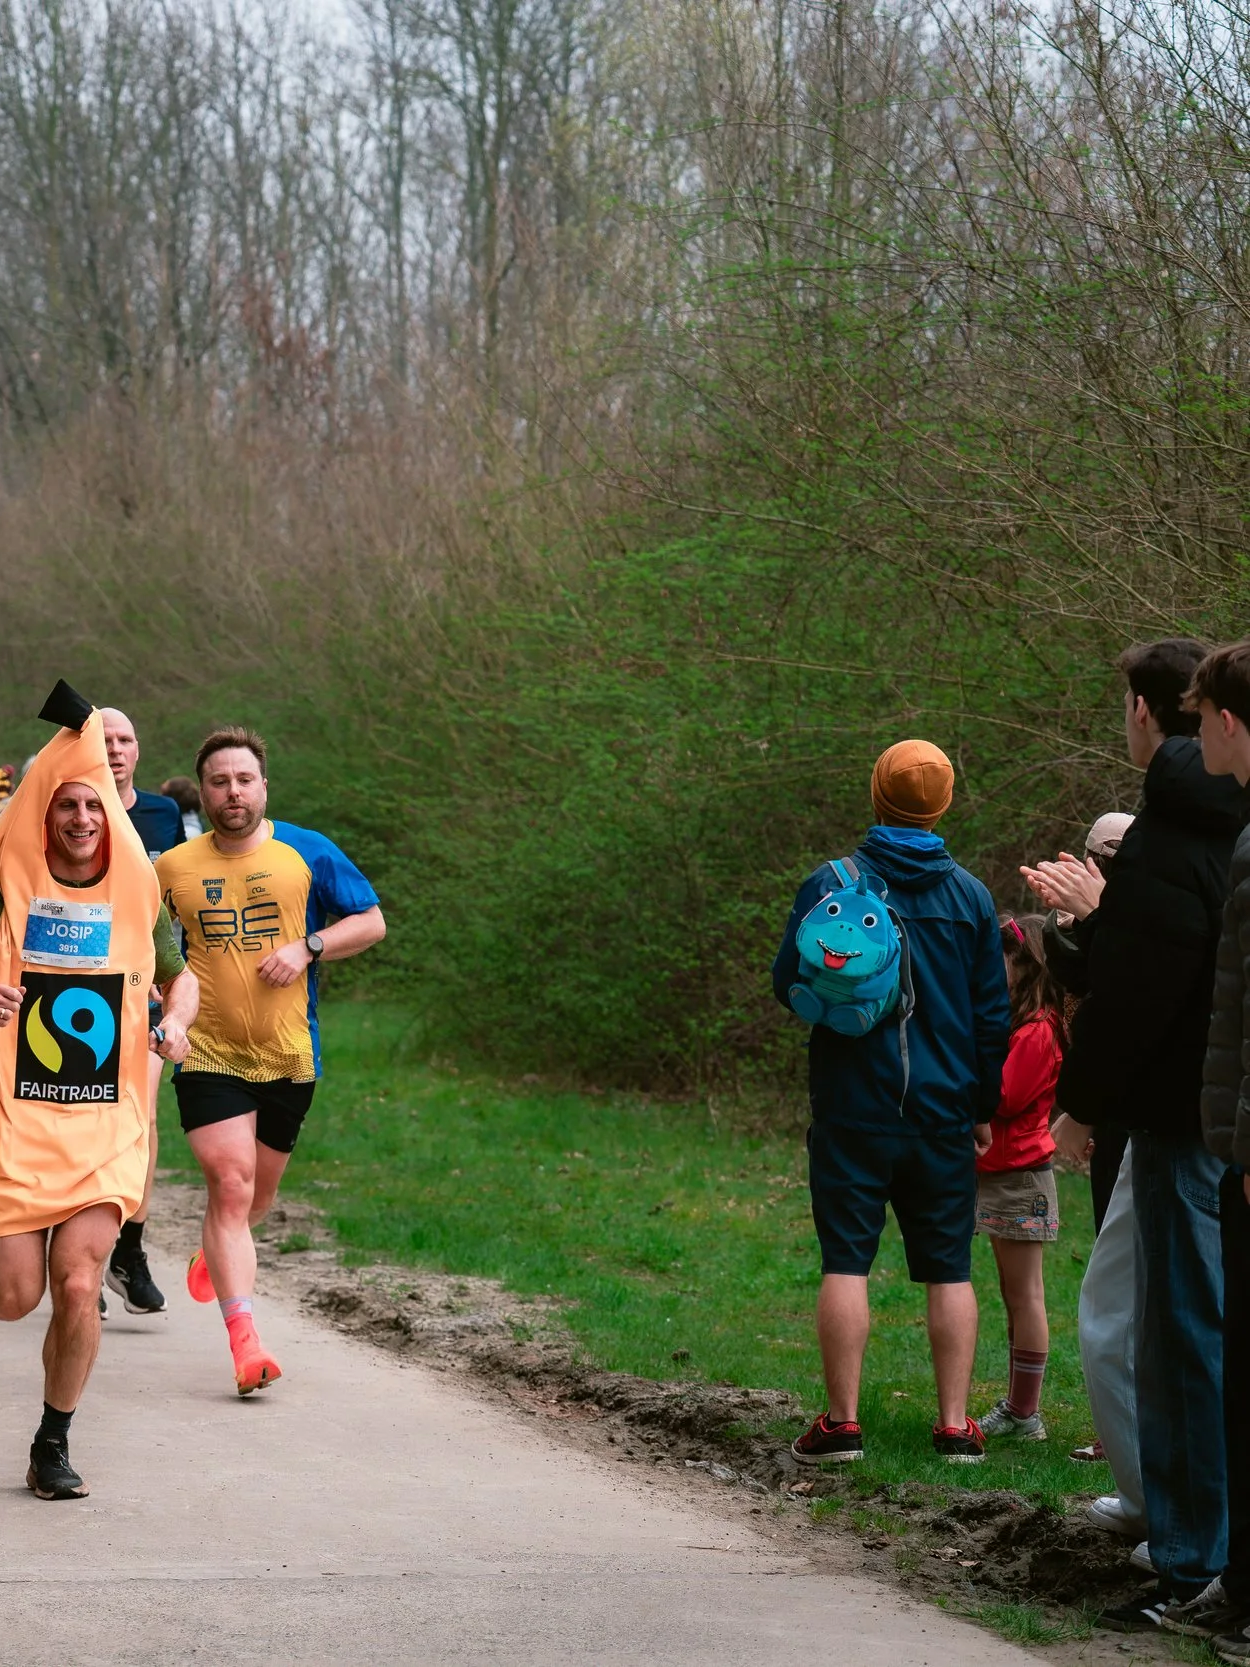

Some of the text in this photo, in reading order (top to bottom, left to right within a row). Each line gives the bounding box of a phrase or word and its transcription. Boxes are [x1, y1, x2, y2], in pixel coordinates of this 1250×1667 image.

[89, 908, 103, 916] 21K
[198, 902, 280, 938] BE
[46, 923, 93, 939] JOSIP
[59, 943, 79, 953] 3913
[205, 933, 280, 954] FAST
[19, 1081, 115, 1101] FAIRTRADE
